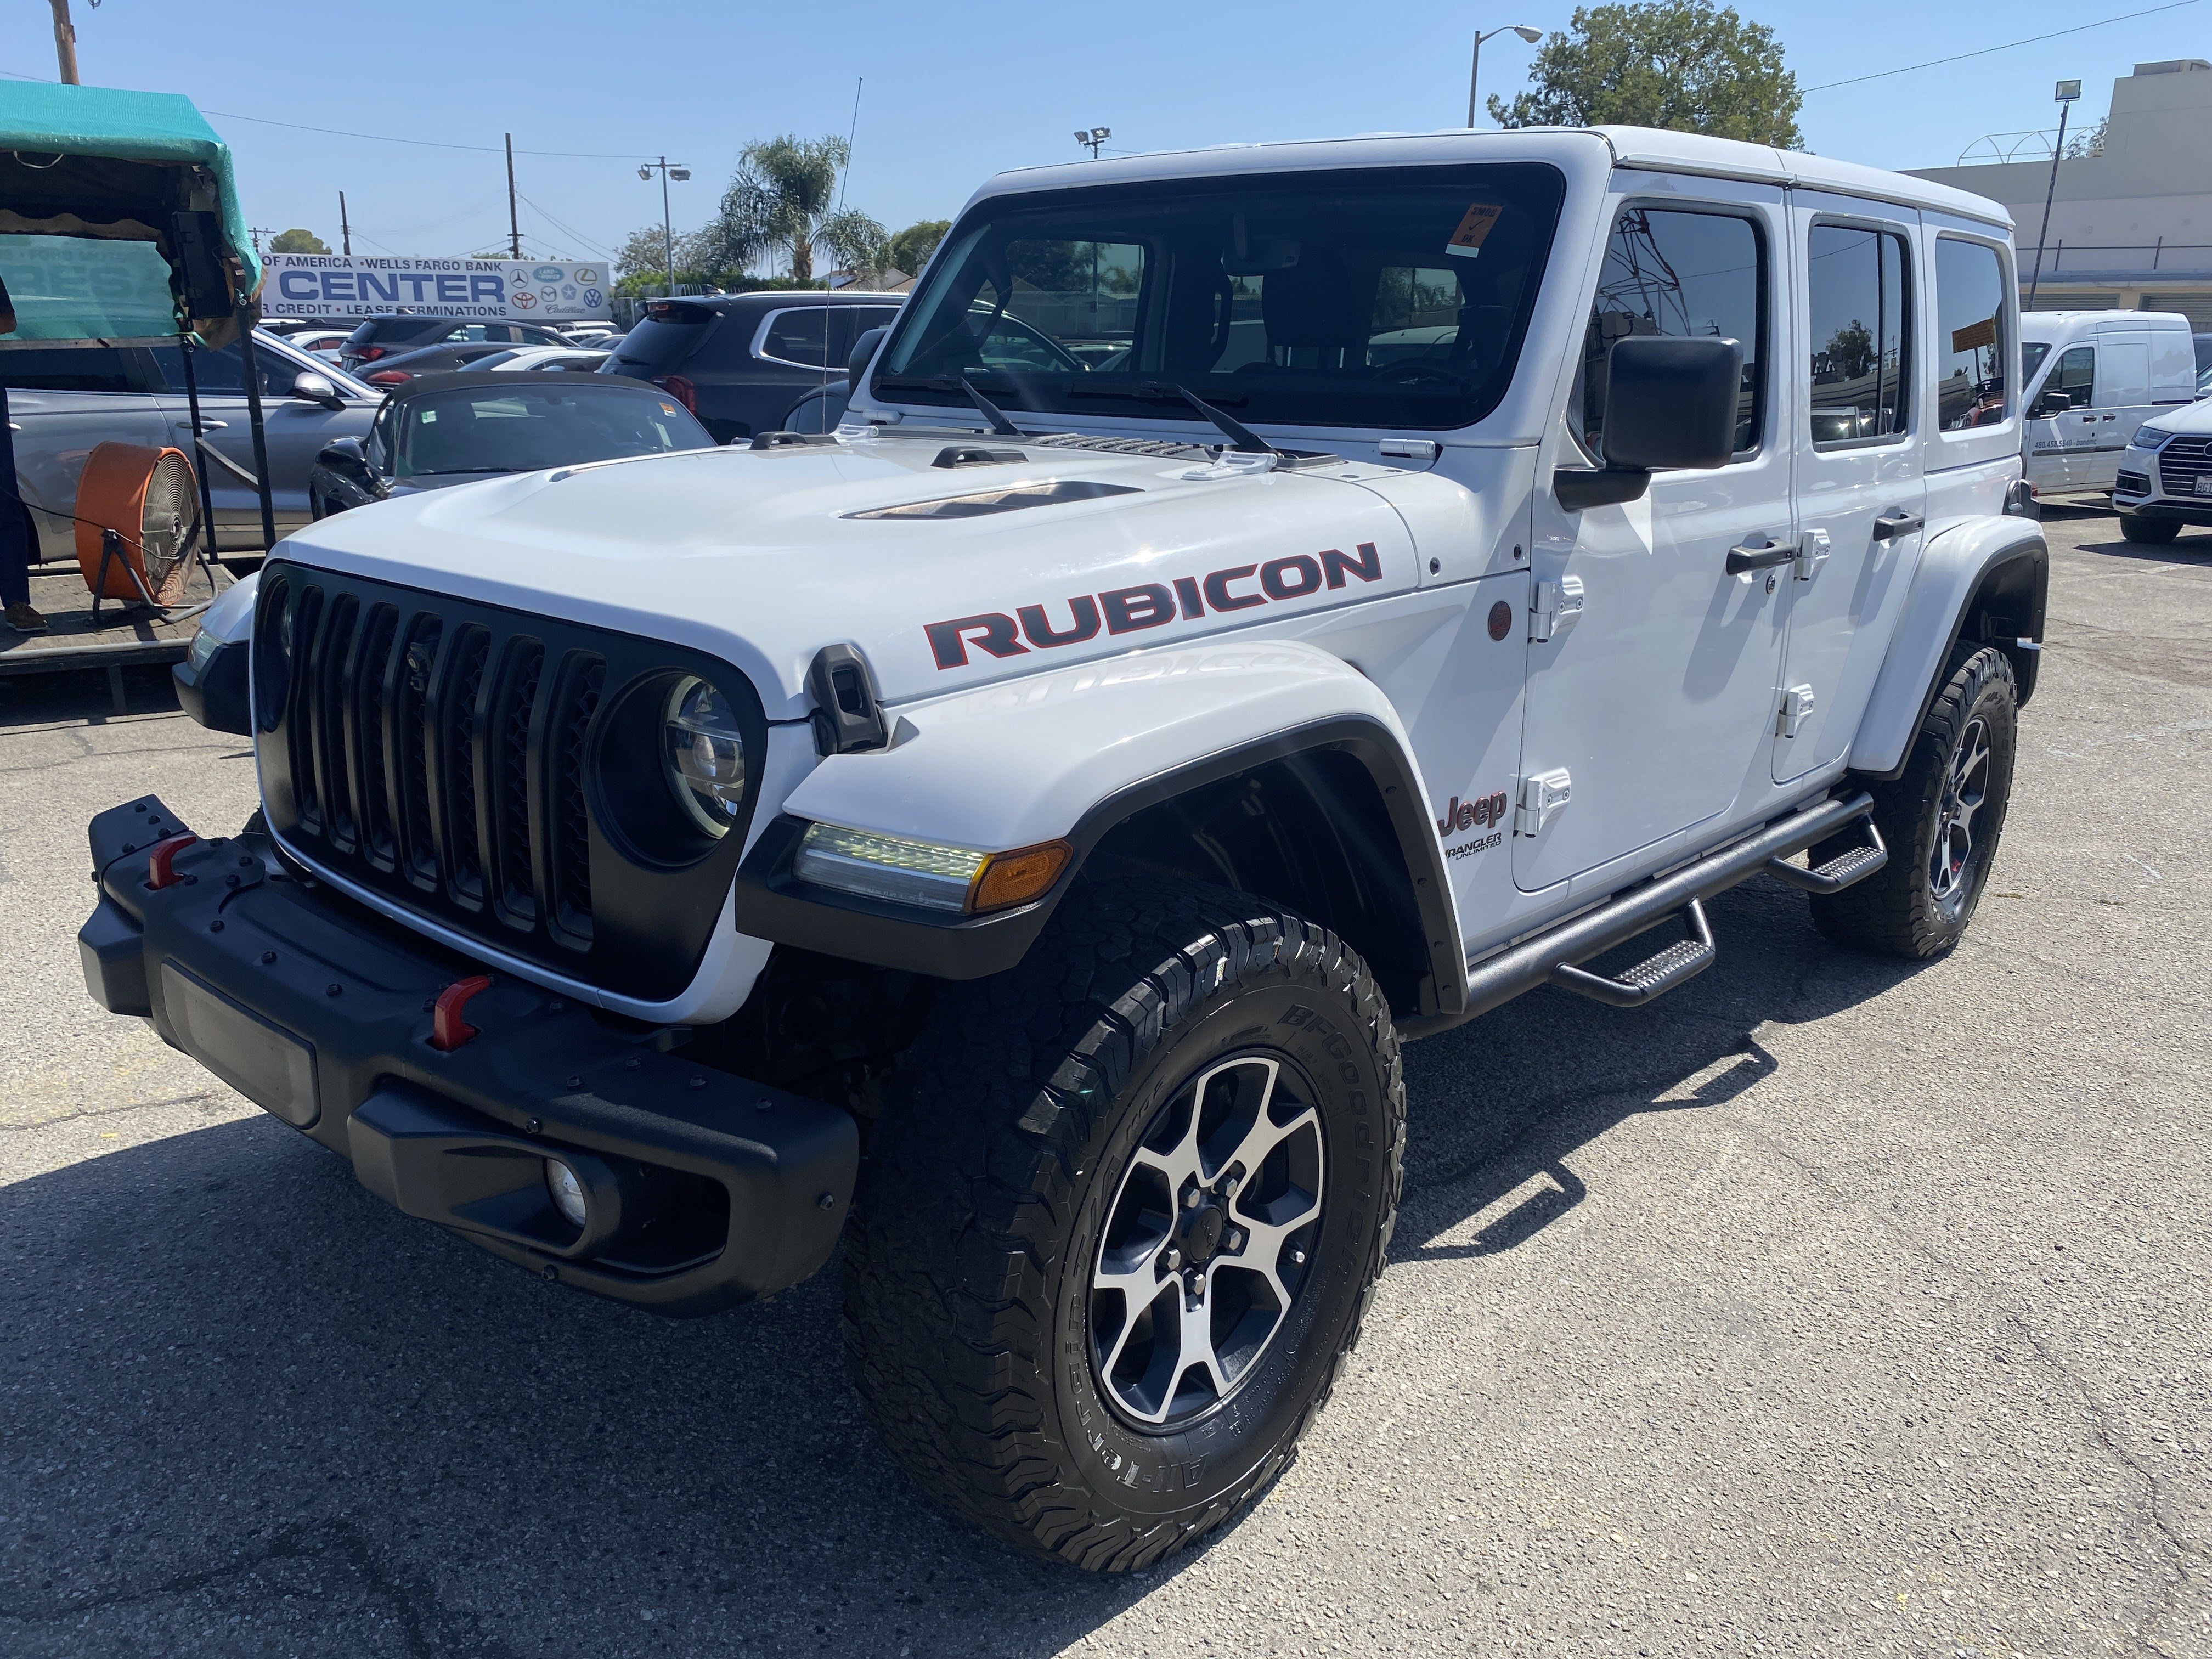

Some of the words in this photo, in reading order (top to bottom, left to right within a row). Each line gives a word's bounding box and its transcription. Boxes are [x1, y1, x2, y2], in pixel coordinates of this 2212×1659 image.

[1462, 234, 1474, 243] OK
[262, 256, 280, 266] OF
[285, 257, 353, 268] AMERICA
[365, 259, 410, 269] WELLS
[415, 260, 460, 270] FARGO
[466, 262, 503, 272] BANK
[280, 270, 505, 302] CENTER
[275, 304, 331, 314] CREDIT
[347, 305, 393, 314] LEASE
[545, 304, 585, 314] Cadillac
[2035, 439, 2072, 449] 480.458.5540
[923, 541, 1383, 670] RUBICON
[1437, 791, 1507, 837] Jeep
[1455, 840, 1502, 861] UNLIMITED
